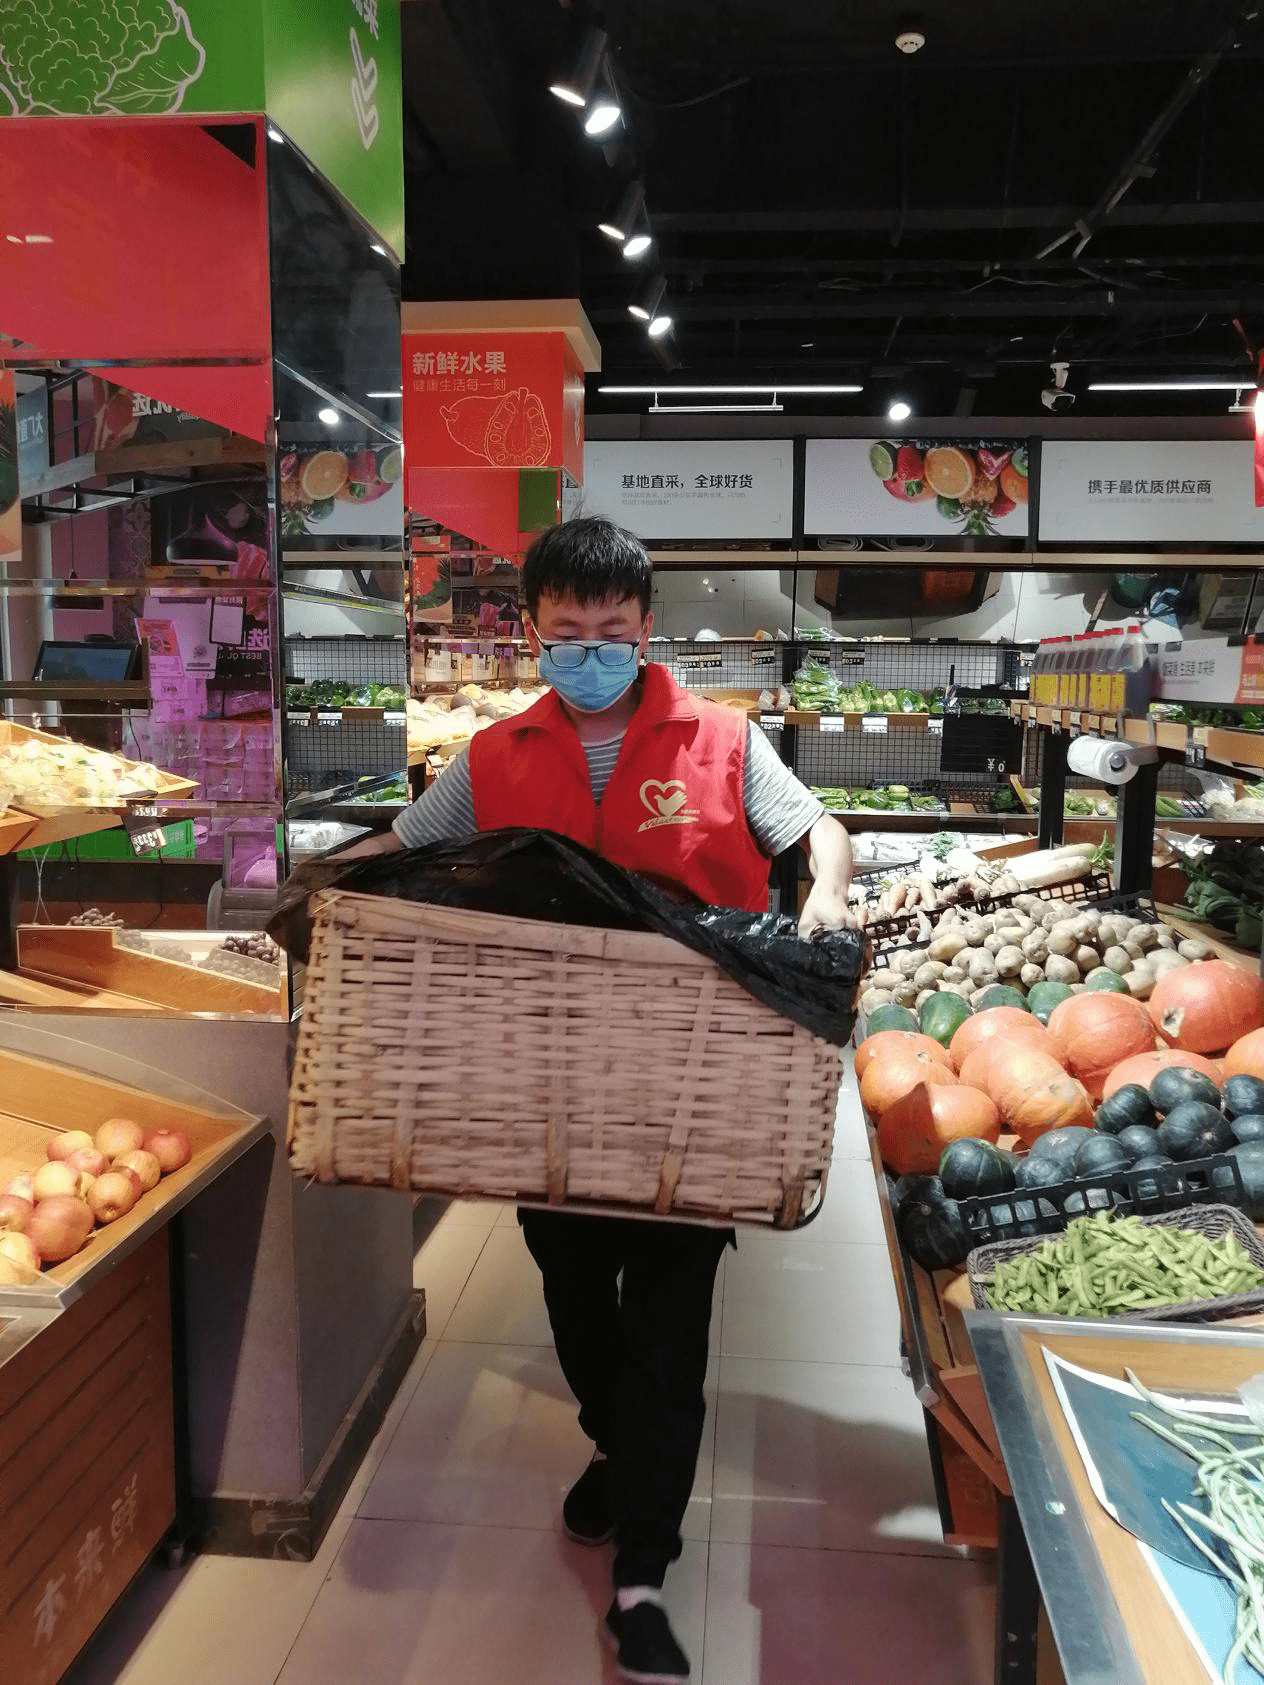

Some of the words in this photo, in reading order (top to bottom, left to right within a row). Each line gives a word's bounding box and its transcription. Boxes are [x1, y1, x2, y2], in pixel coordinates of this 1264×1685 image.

[413, 351, 507, 376] 新鲜水果
[621, 474, 754, 490] 基地直采，全球好货
[1088, 479, 1212, 495] 携手最优质供应商
